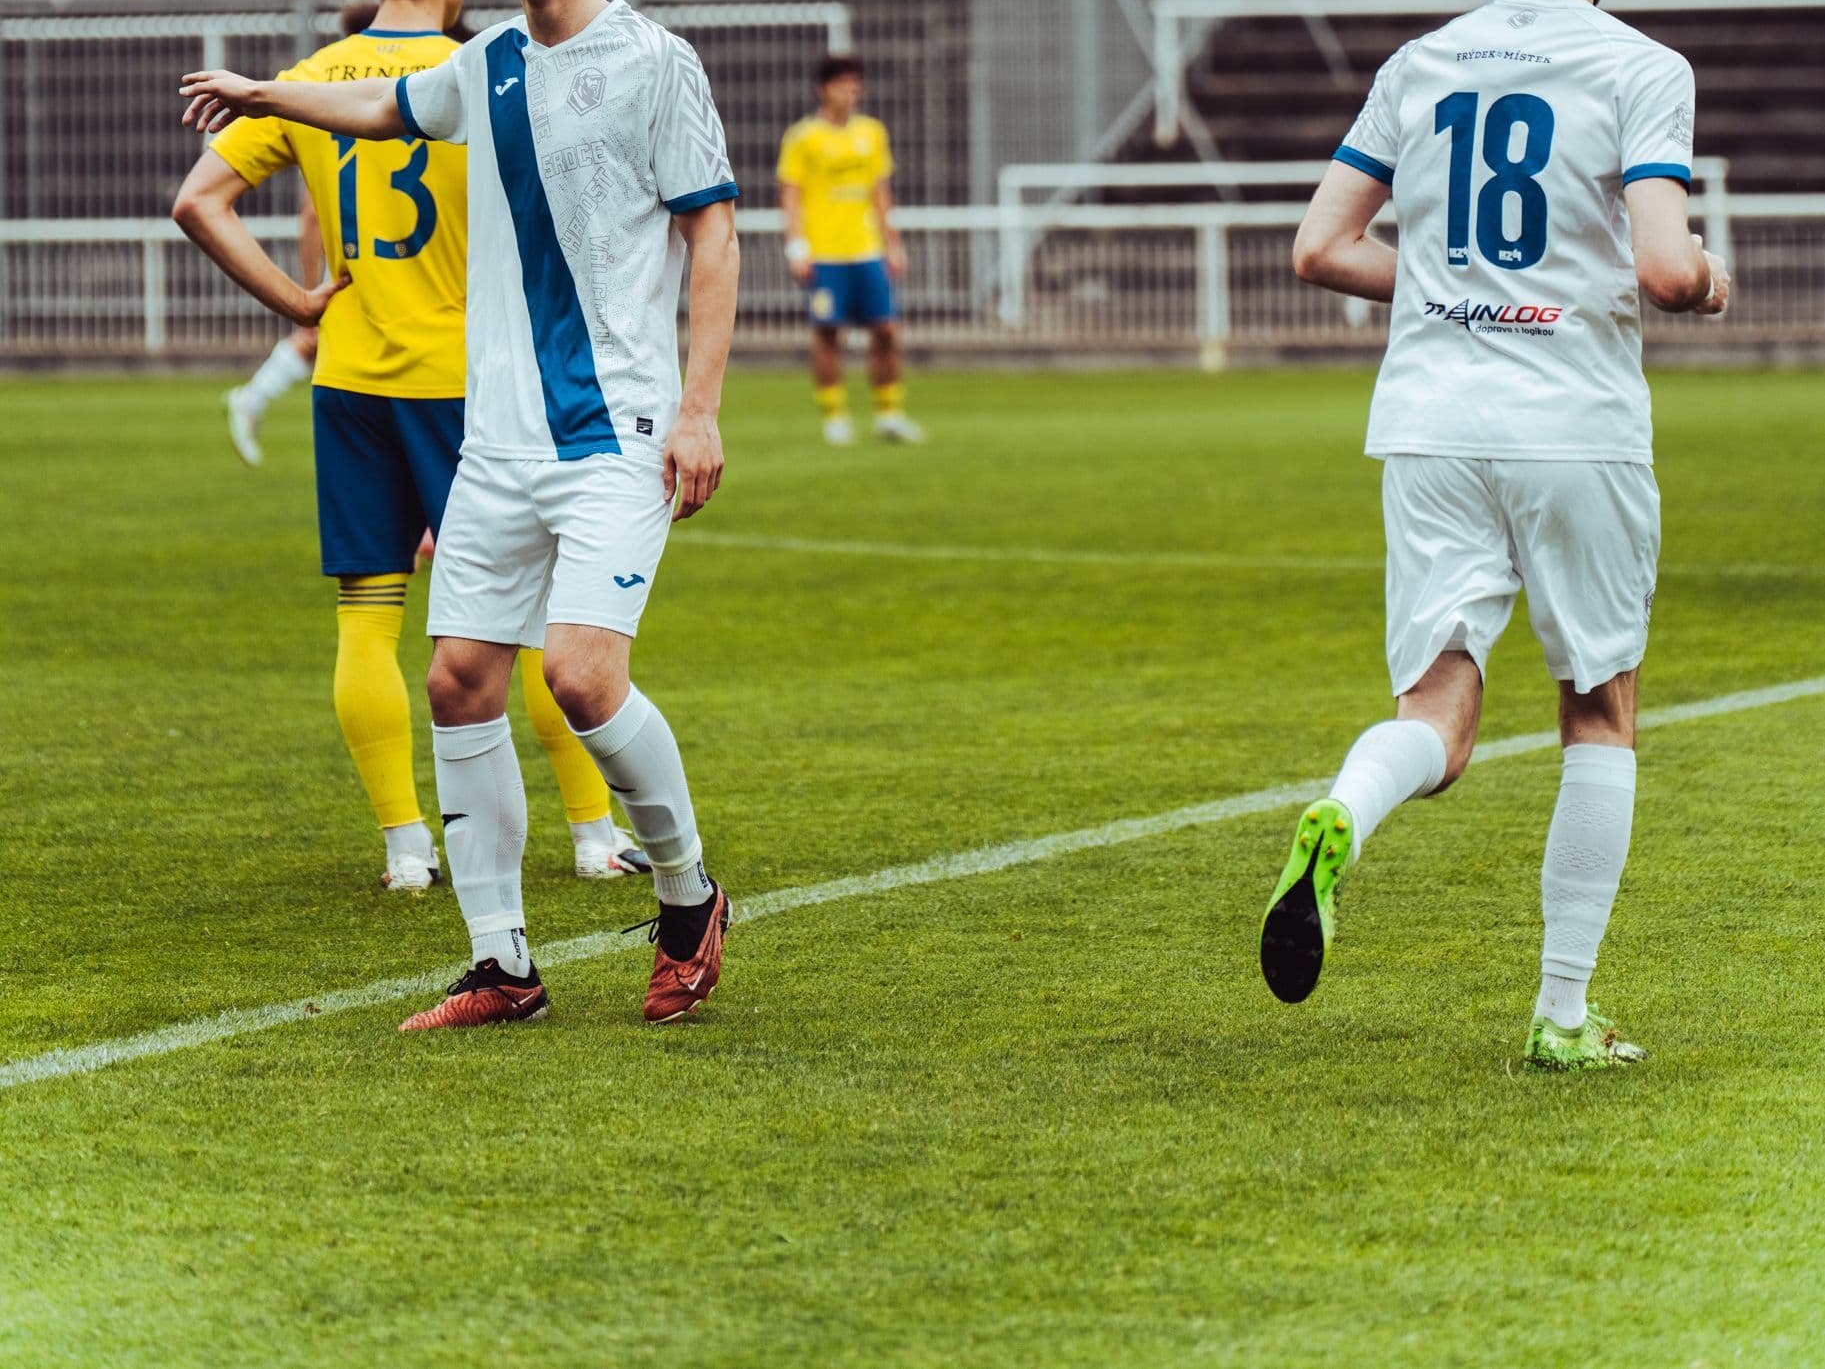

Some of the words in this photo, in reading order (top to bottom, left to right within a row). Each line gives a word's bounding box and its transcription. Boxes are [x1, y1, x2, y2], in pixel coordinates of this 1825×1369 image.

[325, 64, 435, 81] TRINIT
[1504, 50, 1552, 64] MÍSTEK
[331, 132, 437, 259] 13
[1434, 91, 1555, 270] 18
